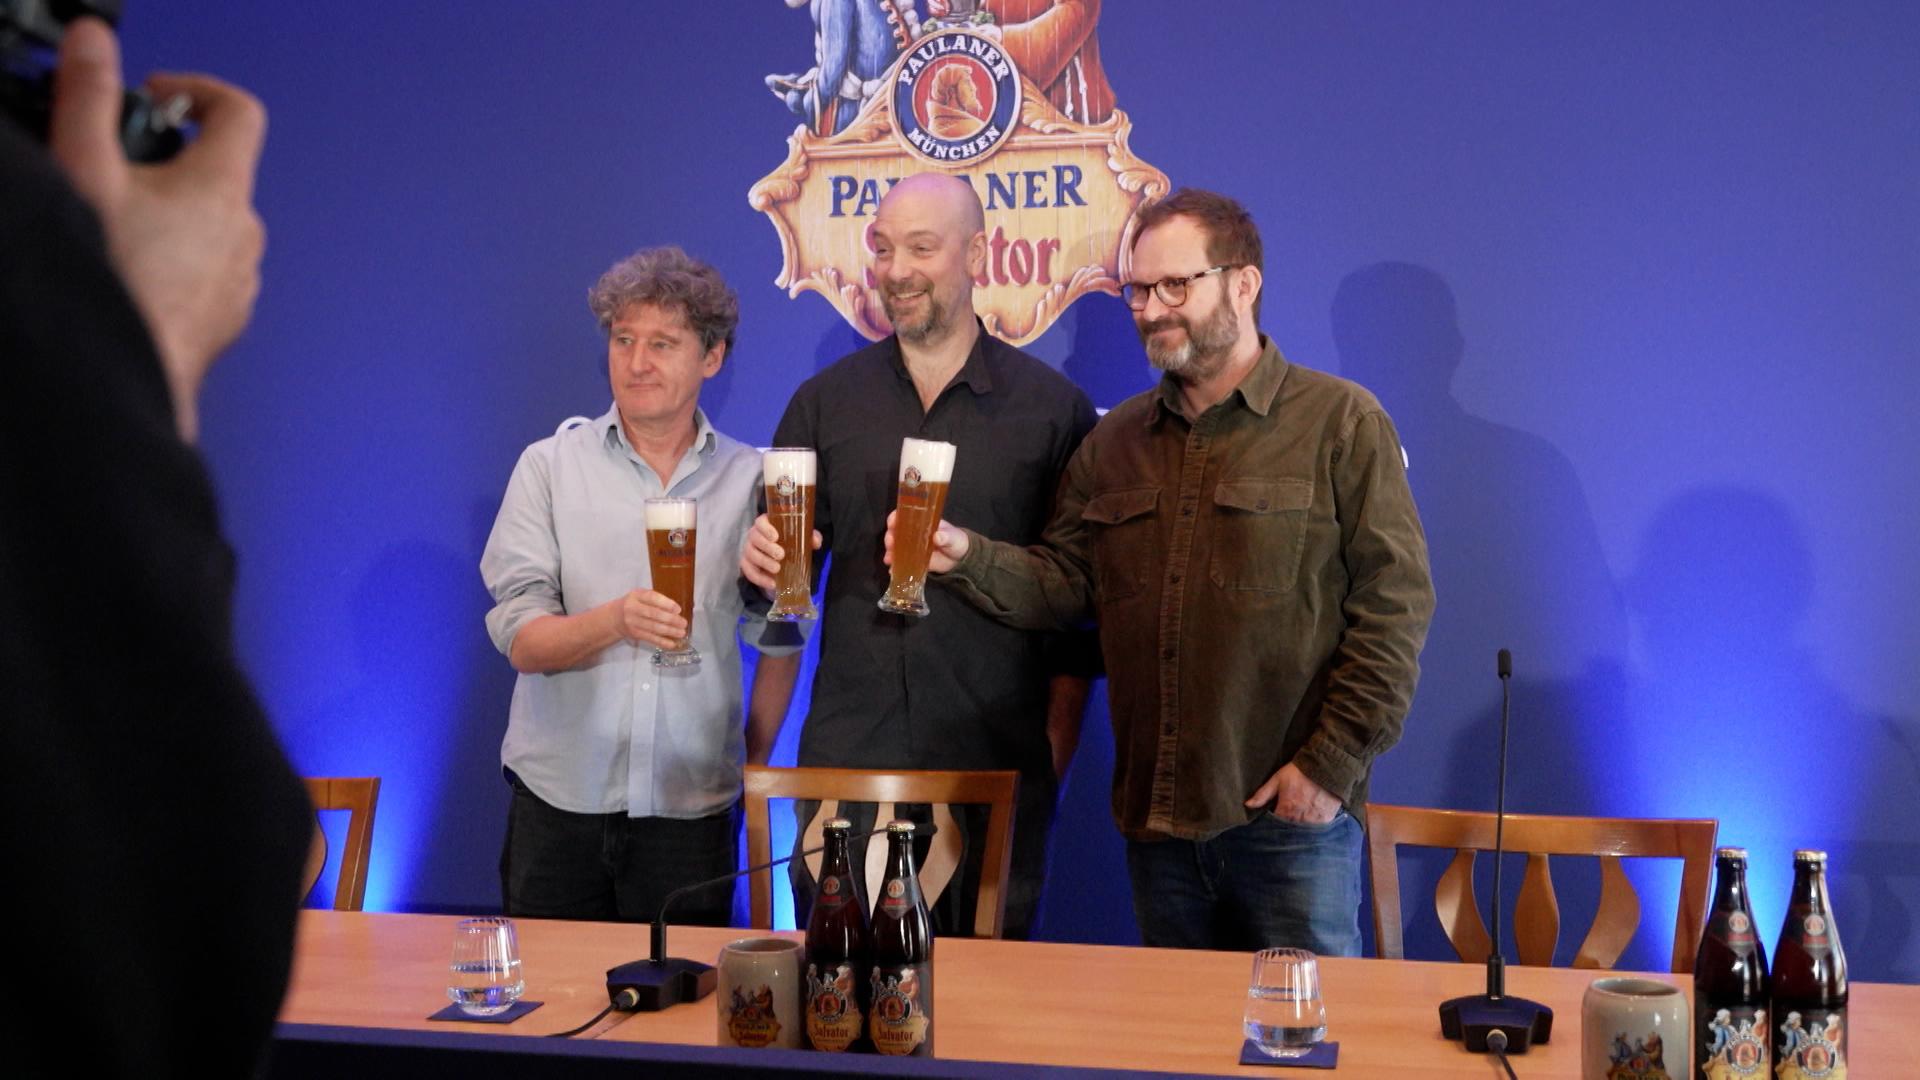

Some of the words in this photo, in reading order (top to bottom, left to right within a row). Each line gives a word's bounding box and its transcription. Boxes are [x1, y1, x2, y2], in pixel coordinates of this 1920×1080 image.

[898, 34, 1010, 86] PAULANER
[907, 124, 1001, 159] MÜNCHEN
[828, 164, 1088, 218] PANER
